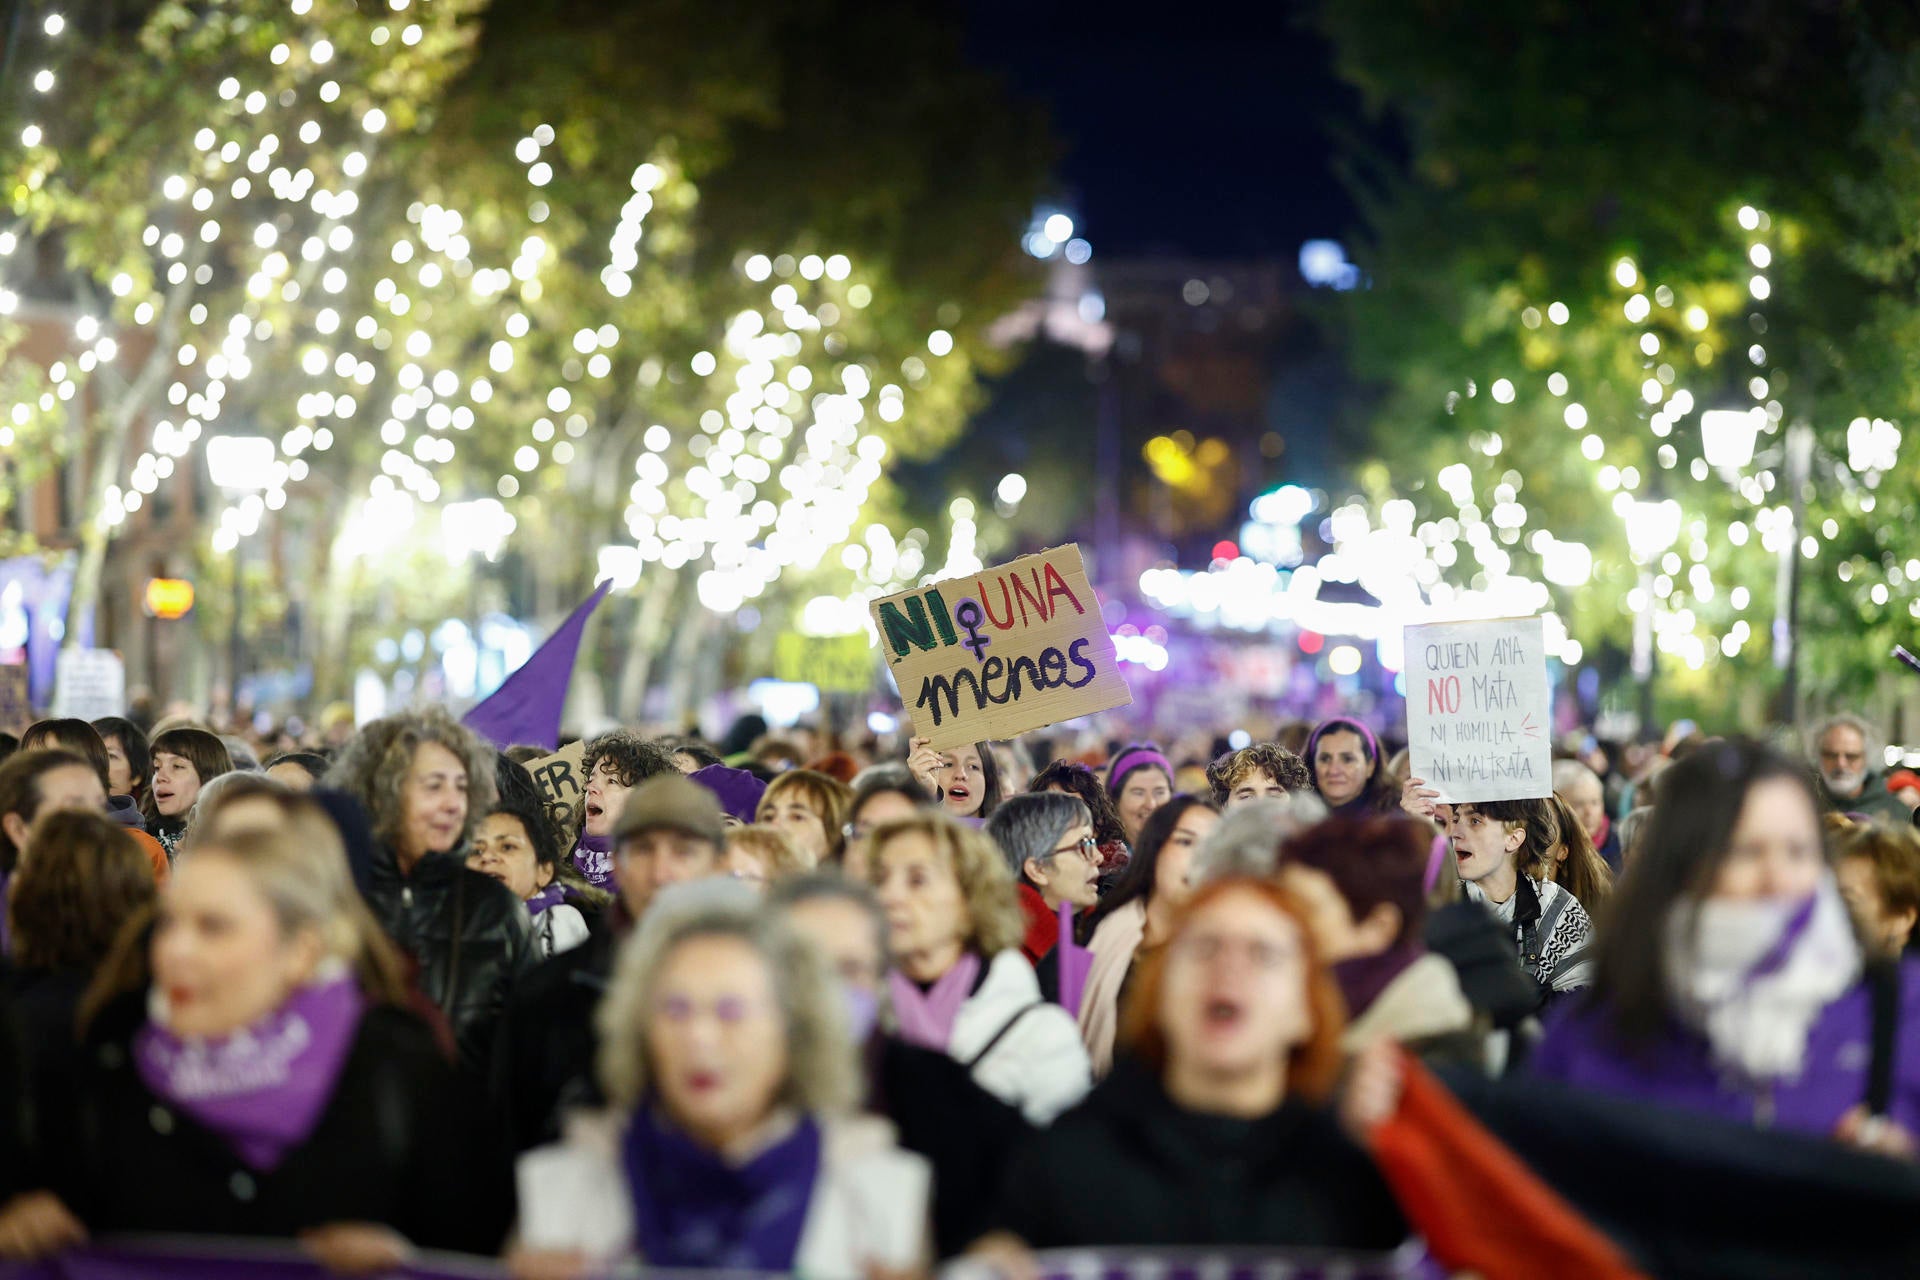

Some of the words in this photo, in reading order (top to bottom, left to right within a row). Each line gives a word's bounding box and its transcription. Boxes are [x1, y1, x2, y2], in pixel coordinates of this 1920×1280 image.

[879, 588, 958, 656] NI
[978, 562, 1086, 630] UNA
[1425, 641, 1479, 671] QUIEN
[1490, 636, 1525, 665] AMA
[916, 638, 1096, 726] menos
[1428, 675, 1461, 715] NO
[1472, 670, 1518, 712] MATA
[1430, 723, 1447, 745] NI
[1455, 720, 1518, 745] HUMILLA
[1433, 752, 1451, 783] NI
[1457, 745, 1533, 783] MALTRATA
